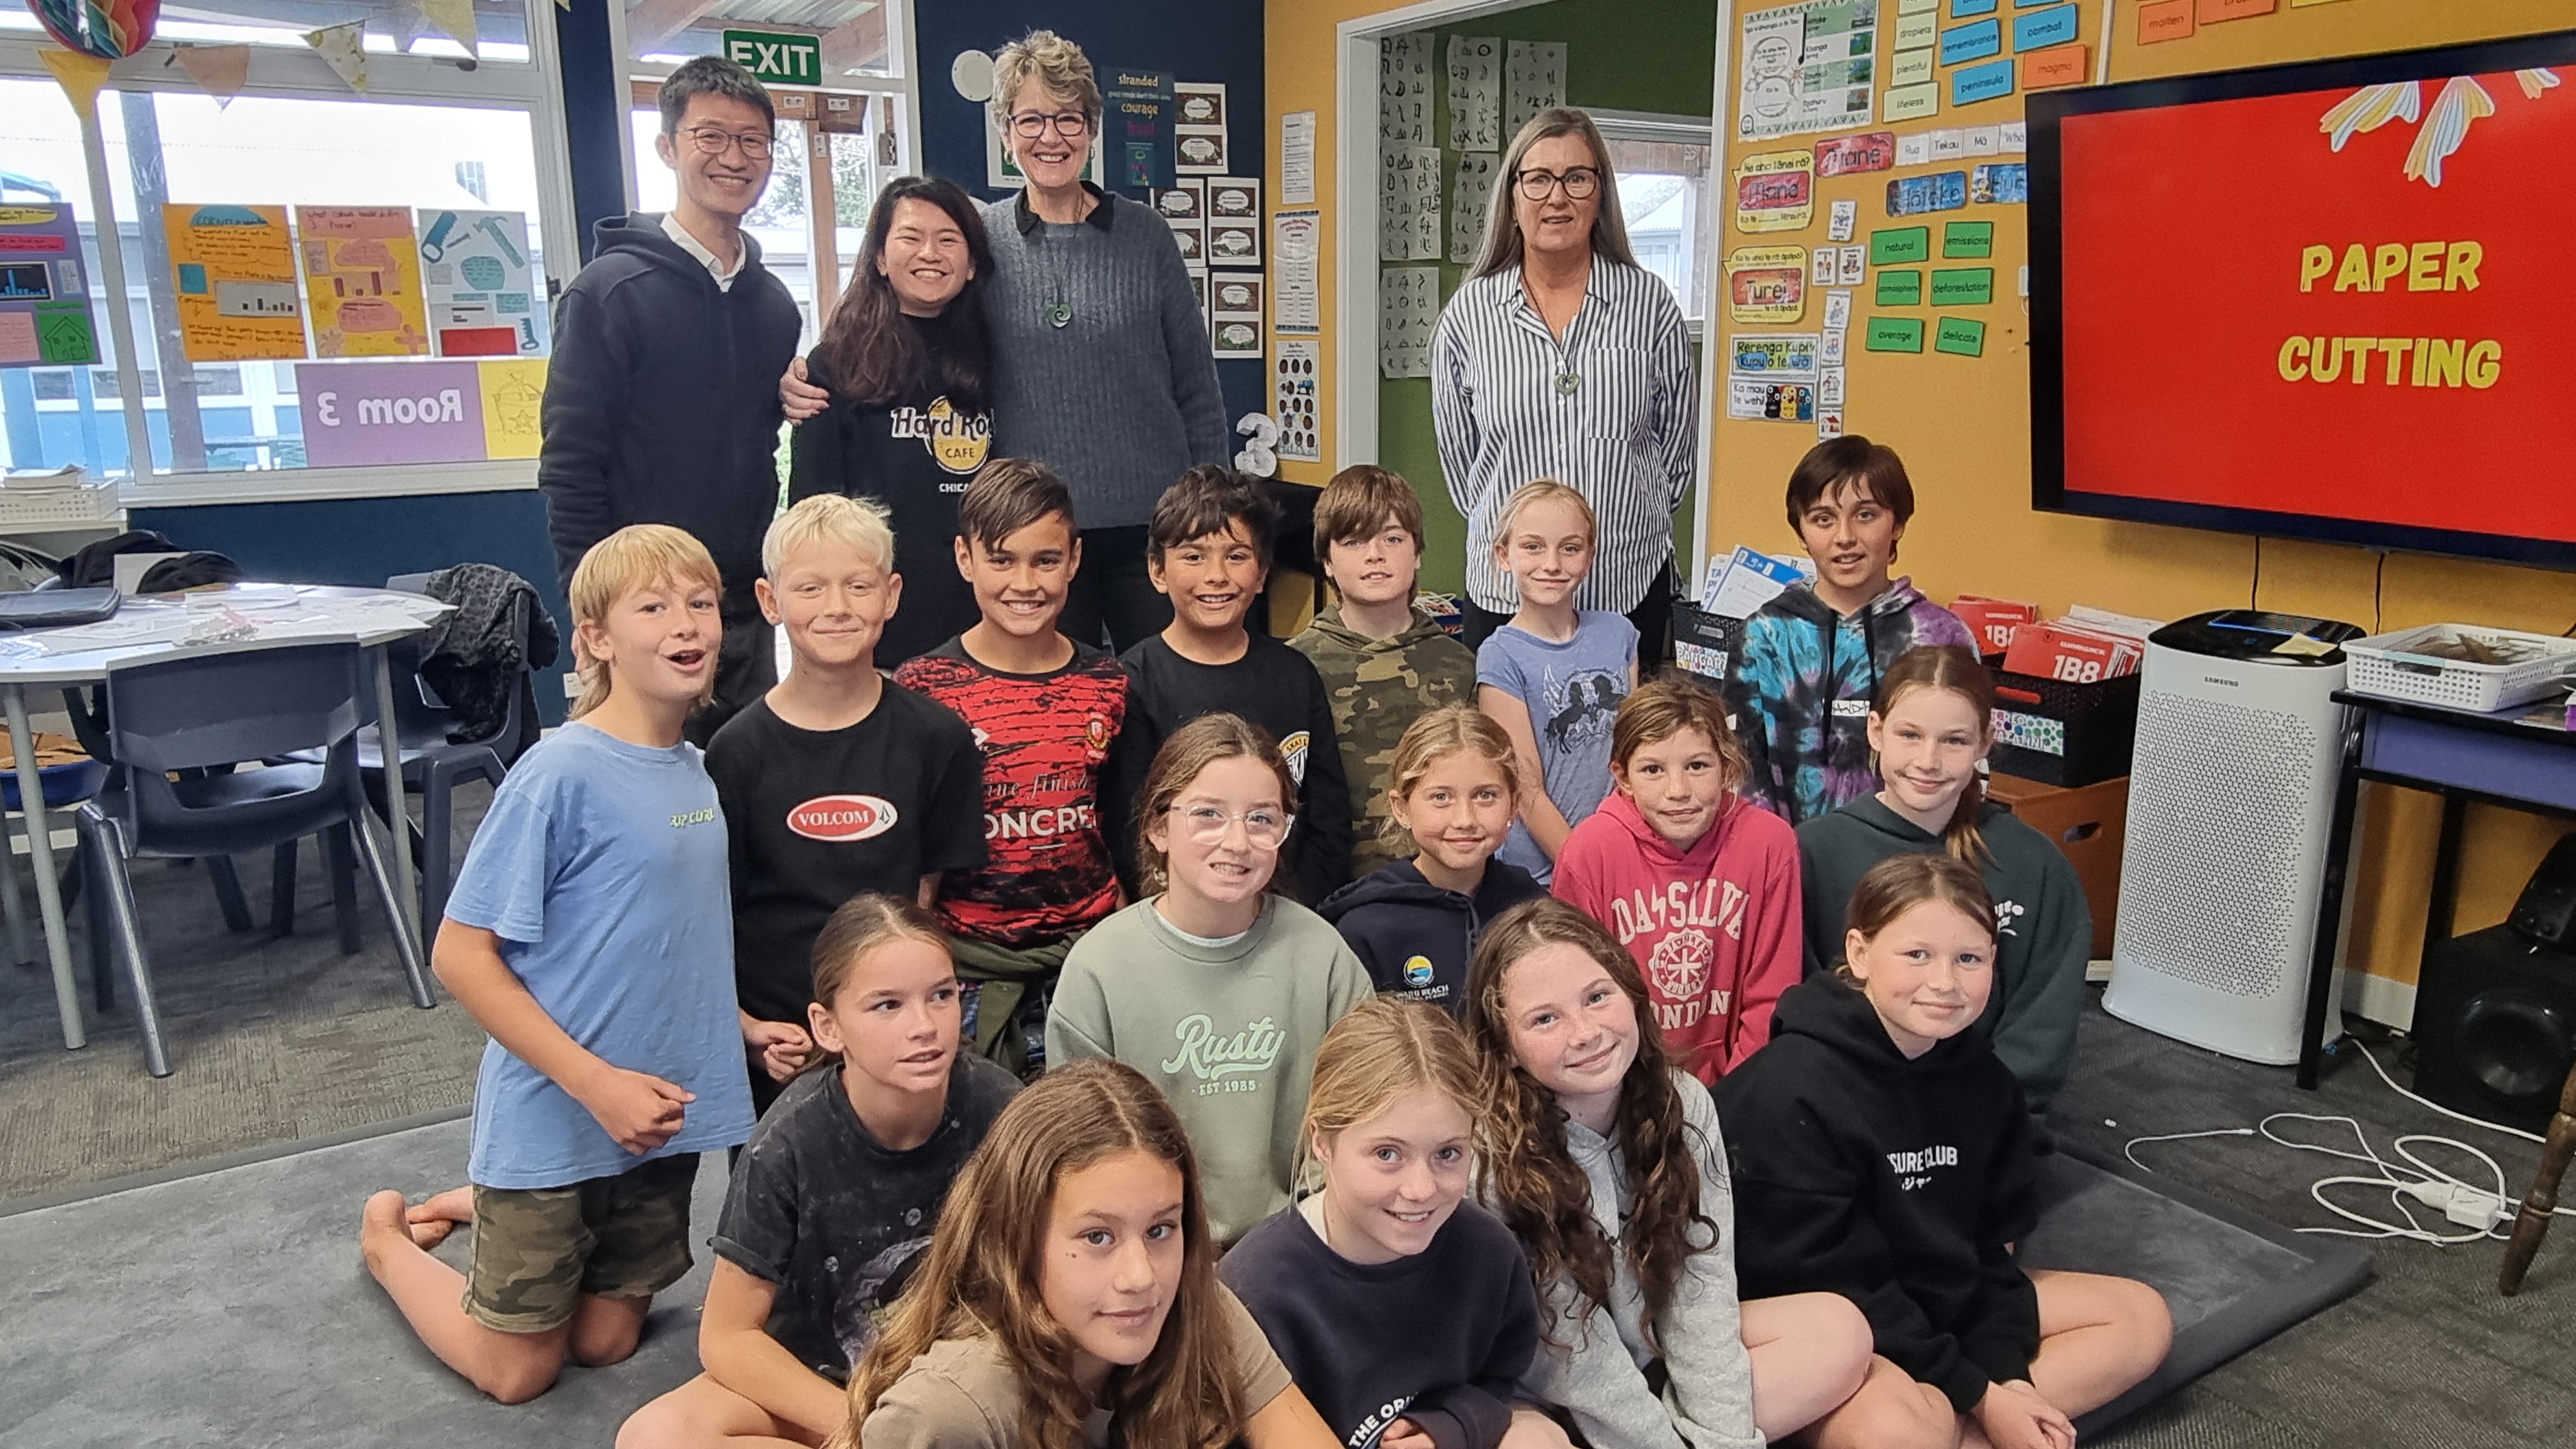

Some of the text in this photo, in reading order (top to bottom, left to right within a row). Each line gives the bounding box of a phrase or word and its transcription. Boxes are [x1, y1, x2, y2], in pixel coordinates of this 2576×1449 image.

[2027, 20, 2062, 38] combat
[2149, 15, 2184, 29] molten
[730, 41, 814, 76] EXIT
[2037, 63, 2072, 75] magma
[1118, 73, 1158, 87] stranded
[1961, 75, 2004, 93] peninsula
[1121, 103, 1159, 119] courage
[1935, 140, 1959, 150] Tekau
[1885, 240, 1914, 252] natural
[2300, 241, 2483, 292] PAPER
[1933, 282, 1989, 293] deforestation
[1878, 331, 1912, 342] average
[1943, 330, 1977, 344] delicate
[1737, 341, 1782, 356] Rerenga
[2278, 335, 2502, 388] CUTTING
[891, 407, 954, 438] Hard
[946, 448, 976, 458] CAFE
[1235, 413, 1277, 477] 3
[2052, 655, 2101, 684] 1B8
[1027, 771, 1089, 800] finish
[670, 808, 715, 828] RIP CURL
[798, 810, 870, 827] VOLCOM
[984, 802, 1097, 839] ONCRE
[1421, 984, 1449, 997] BEACH
[1162, 1013, 1286, 1081] Rusty
[1199, 1079, 1257, 1096] EST 1985
[1348, 1414, 1380, 1447] THE
